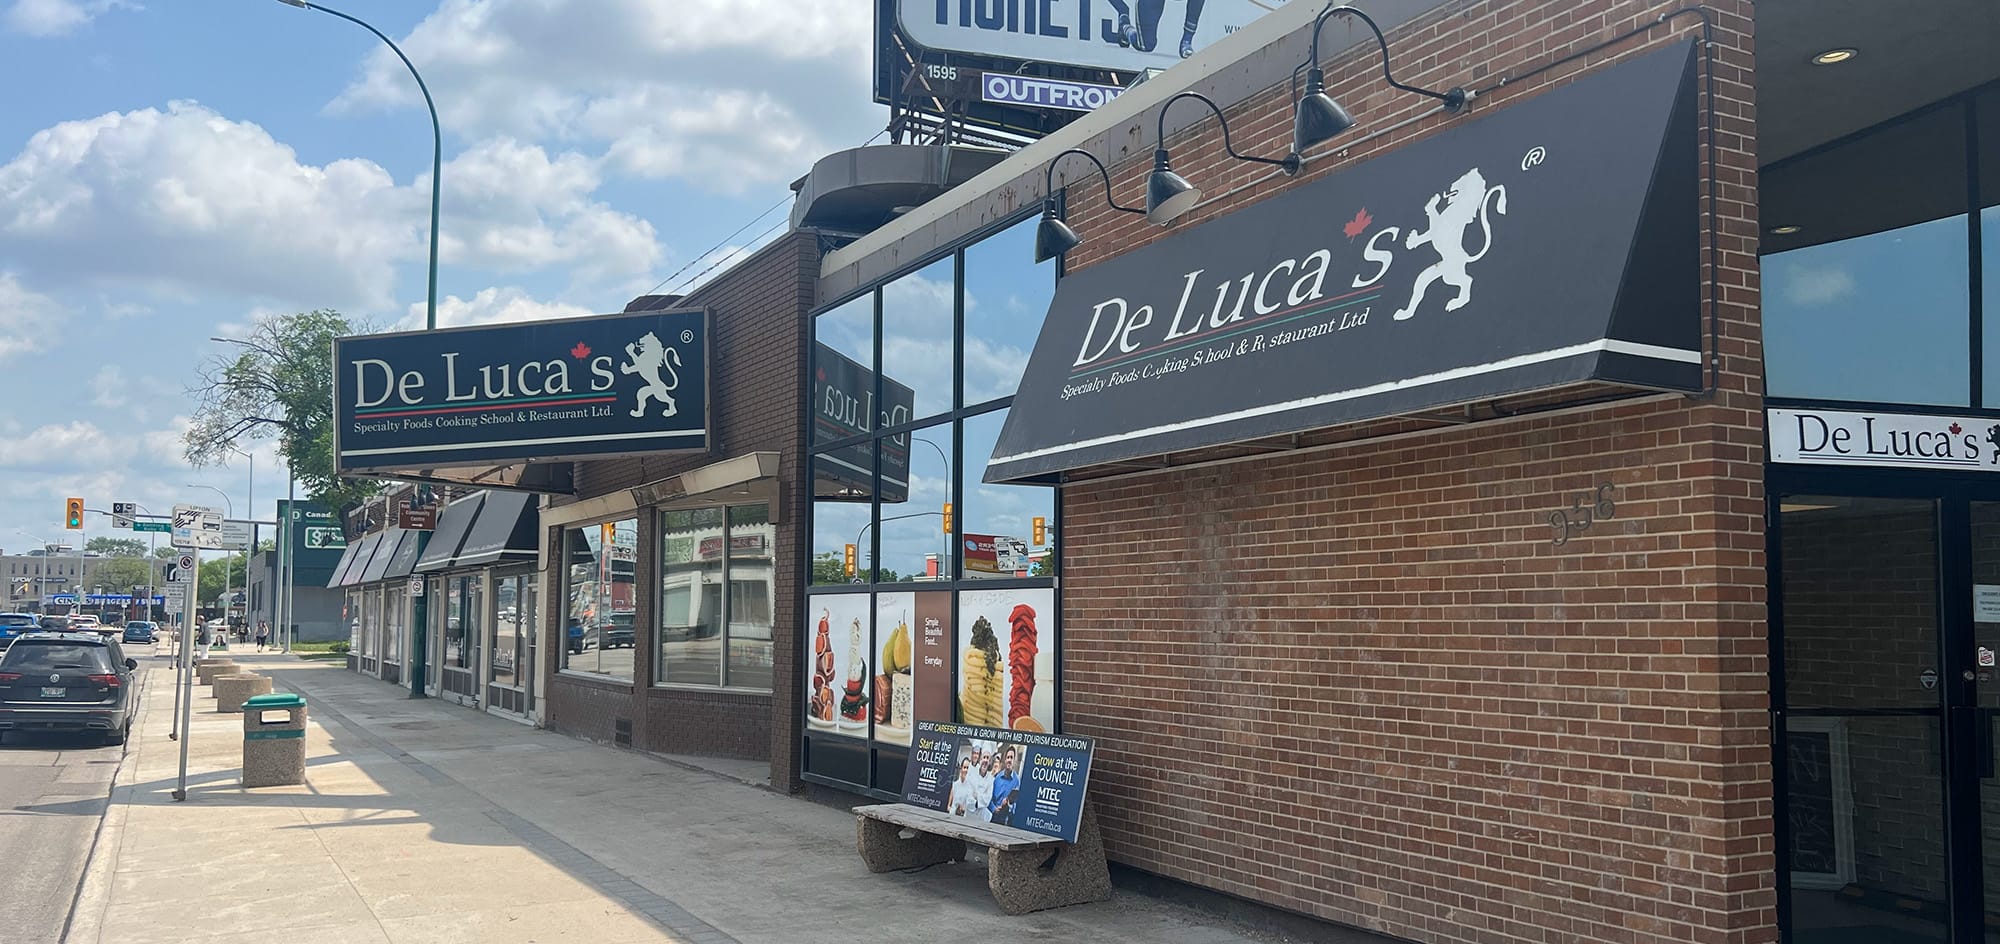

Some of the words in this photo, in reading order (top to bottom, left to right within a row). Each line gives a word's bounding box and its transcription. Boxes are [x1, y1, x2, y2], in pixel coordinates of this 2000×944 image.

[927, 65, 956, 80] 1595
[1073, 298, 1153, 366] De
[1061, 378, 1107, 400] Specialty
[1108, 369, 1140, 388] Foods
[1236, 338, 1249, 355] &
[1339, 307, 1371, 330] Ltd
[352, 359, 425, 407] De
[354, 421, 400, 434] Specialty
[403, 418, 433, 430] Foods
[435, 415, 478, 428] Cooking
[480, 412, 514, 425] School
[517, 411, 526, 422] &
[529, 410, 589, 422] Restaurant
[591, 405, 614, 417] Ltd.
[1794, 414, 1851, 453] De
[1549, 481, 1615, 546] 956
[925, 617, 939, 628] Simple
[925, 627, 943, 636] Beautiful
[925, 655, 943, 668] Everyday
[918, 722, 934, 731] GREAT
[934, 724, 957, 734] CAREERS
[956, 726, 974, 737] BEGIN
[973, 729, 979, 737] &
[979, 729, 997, 740] GROW
[997, 731, 1012, 741] WITH
[1012, 733, 1023, 742] MB
[1023, 734, 1050, 746] TOURISM
[1050, 738, 1088, 750] EDUCATION
[918, 738, 934, 750] Start
[934, 741, 941, 751] at
[941, 740, 952, 752] the
[916, 750, 950, 766] COLLEGE
[1034, 753, 1055, 768] Grow
[1055, 757, 1065, 768] at
[1065, 757, 1078, 771] the
[920, 767, 938, 780] MTEC
[1031, 767, 1074, 786] COUNCIL
[1037, 786, 1061, 802] MTEC
[1025, 816, 1062, 833] MTEC.mb.ca
